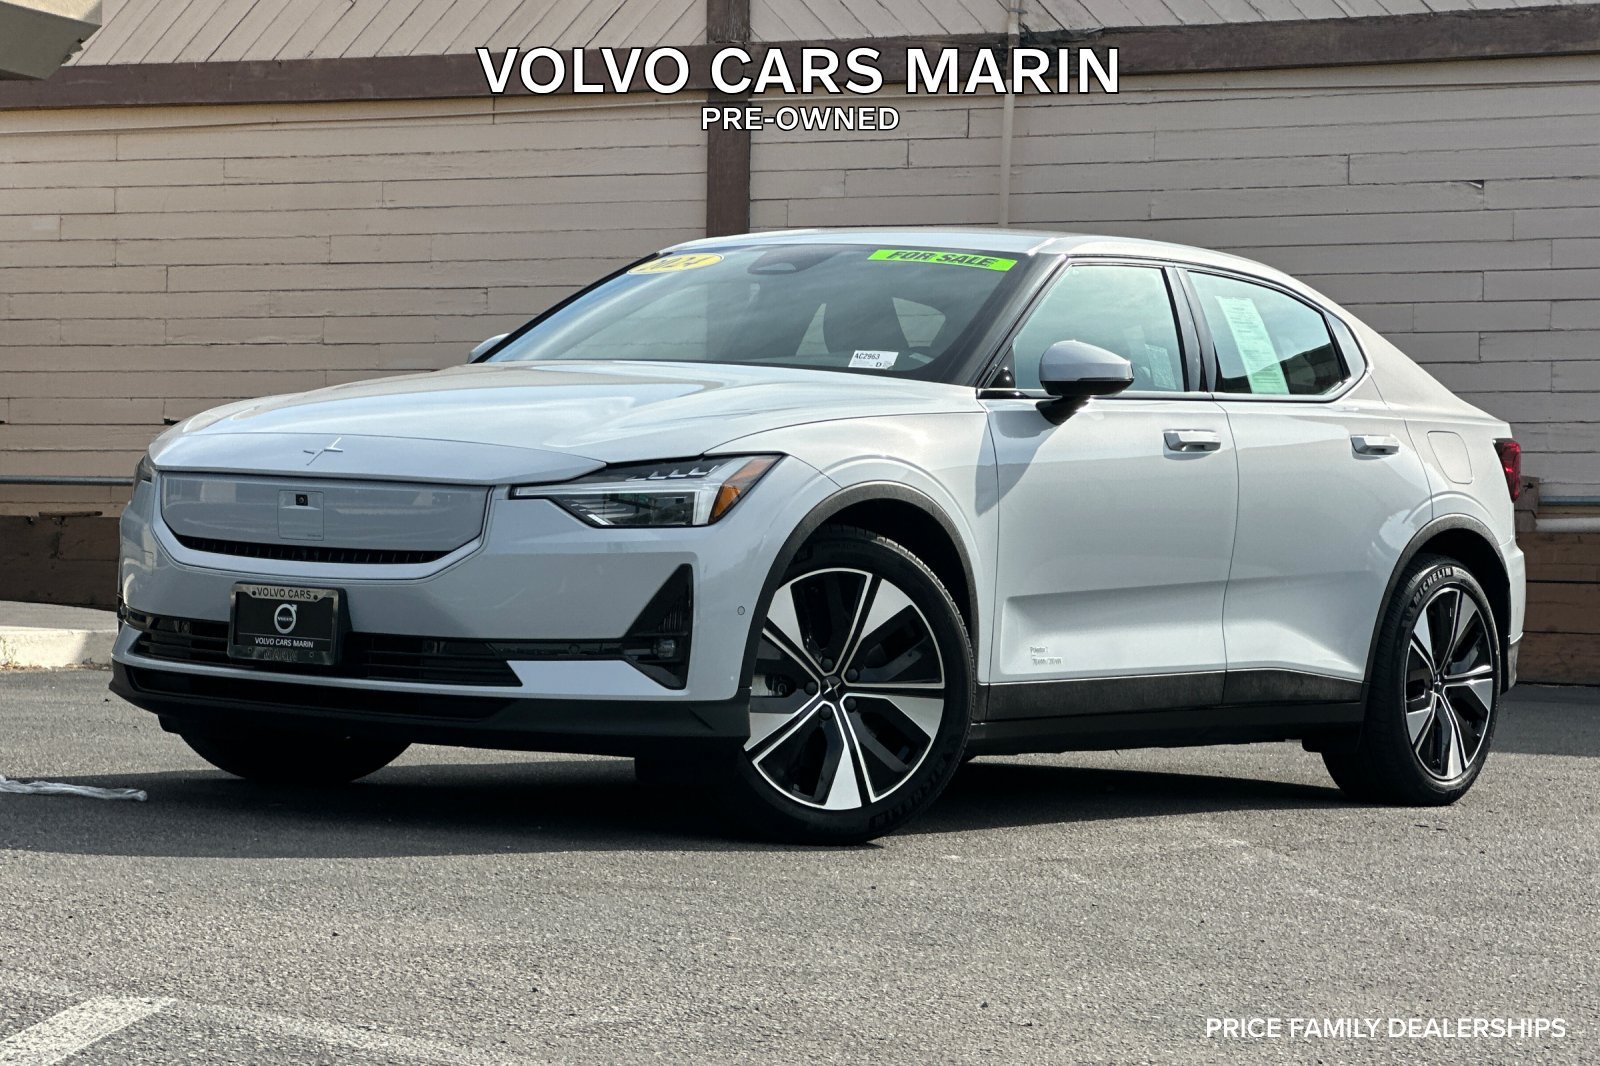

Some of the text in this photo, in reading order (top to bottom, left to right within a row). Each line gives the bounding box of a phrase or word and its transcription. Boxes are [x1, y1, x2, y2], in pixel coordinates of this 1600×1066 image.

[887, 251, 996, 266] FOR SALE
[1414, 567, 1453, 604] MICHELIN
[256, 587, 312, 600] VOLVO CARS
[254, 637, 314, 649] VOLVO CARS MARIN
